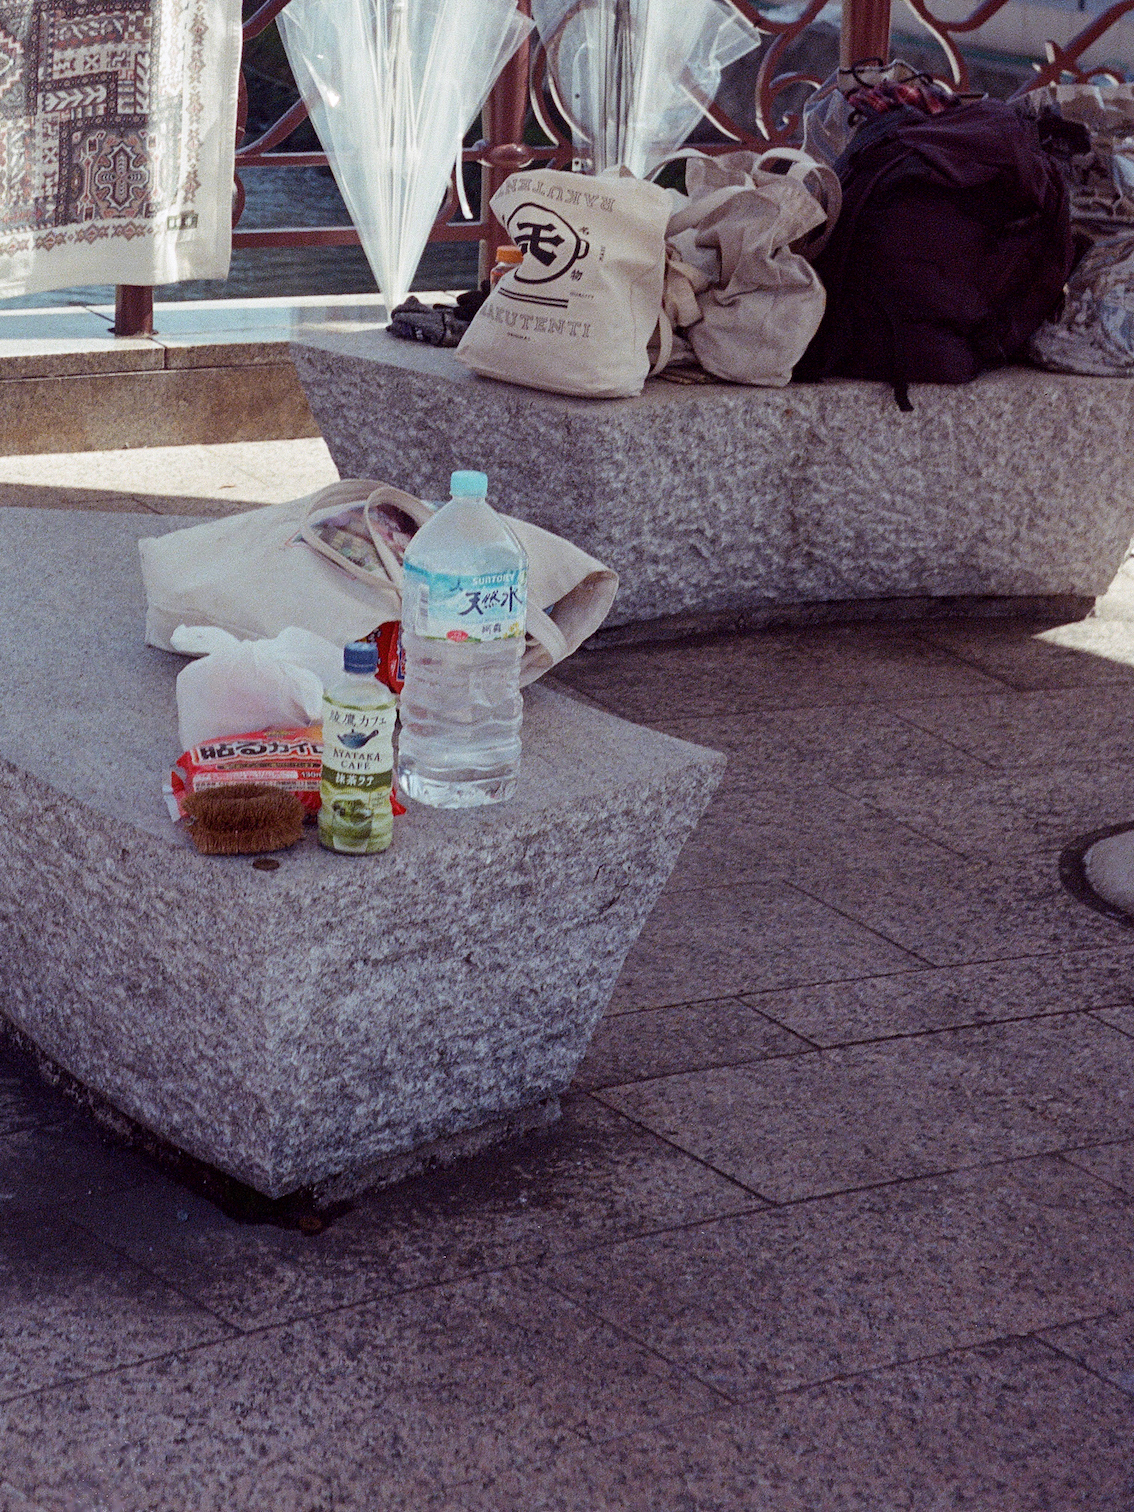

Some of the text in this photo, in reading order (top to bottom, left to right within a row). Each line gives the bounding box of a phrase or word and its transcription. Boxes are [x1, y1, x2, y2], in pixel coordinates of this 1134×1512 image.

[472, 572, 515, 586] SUNTORY
[458, 585, 523, 616] 天然水
[333, 748, 381, 762] AYATAKA
[335, 772, 374, 787] 抹茶ラテ
